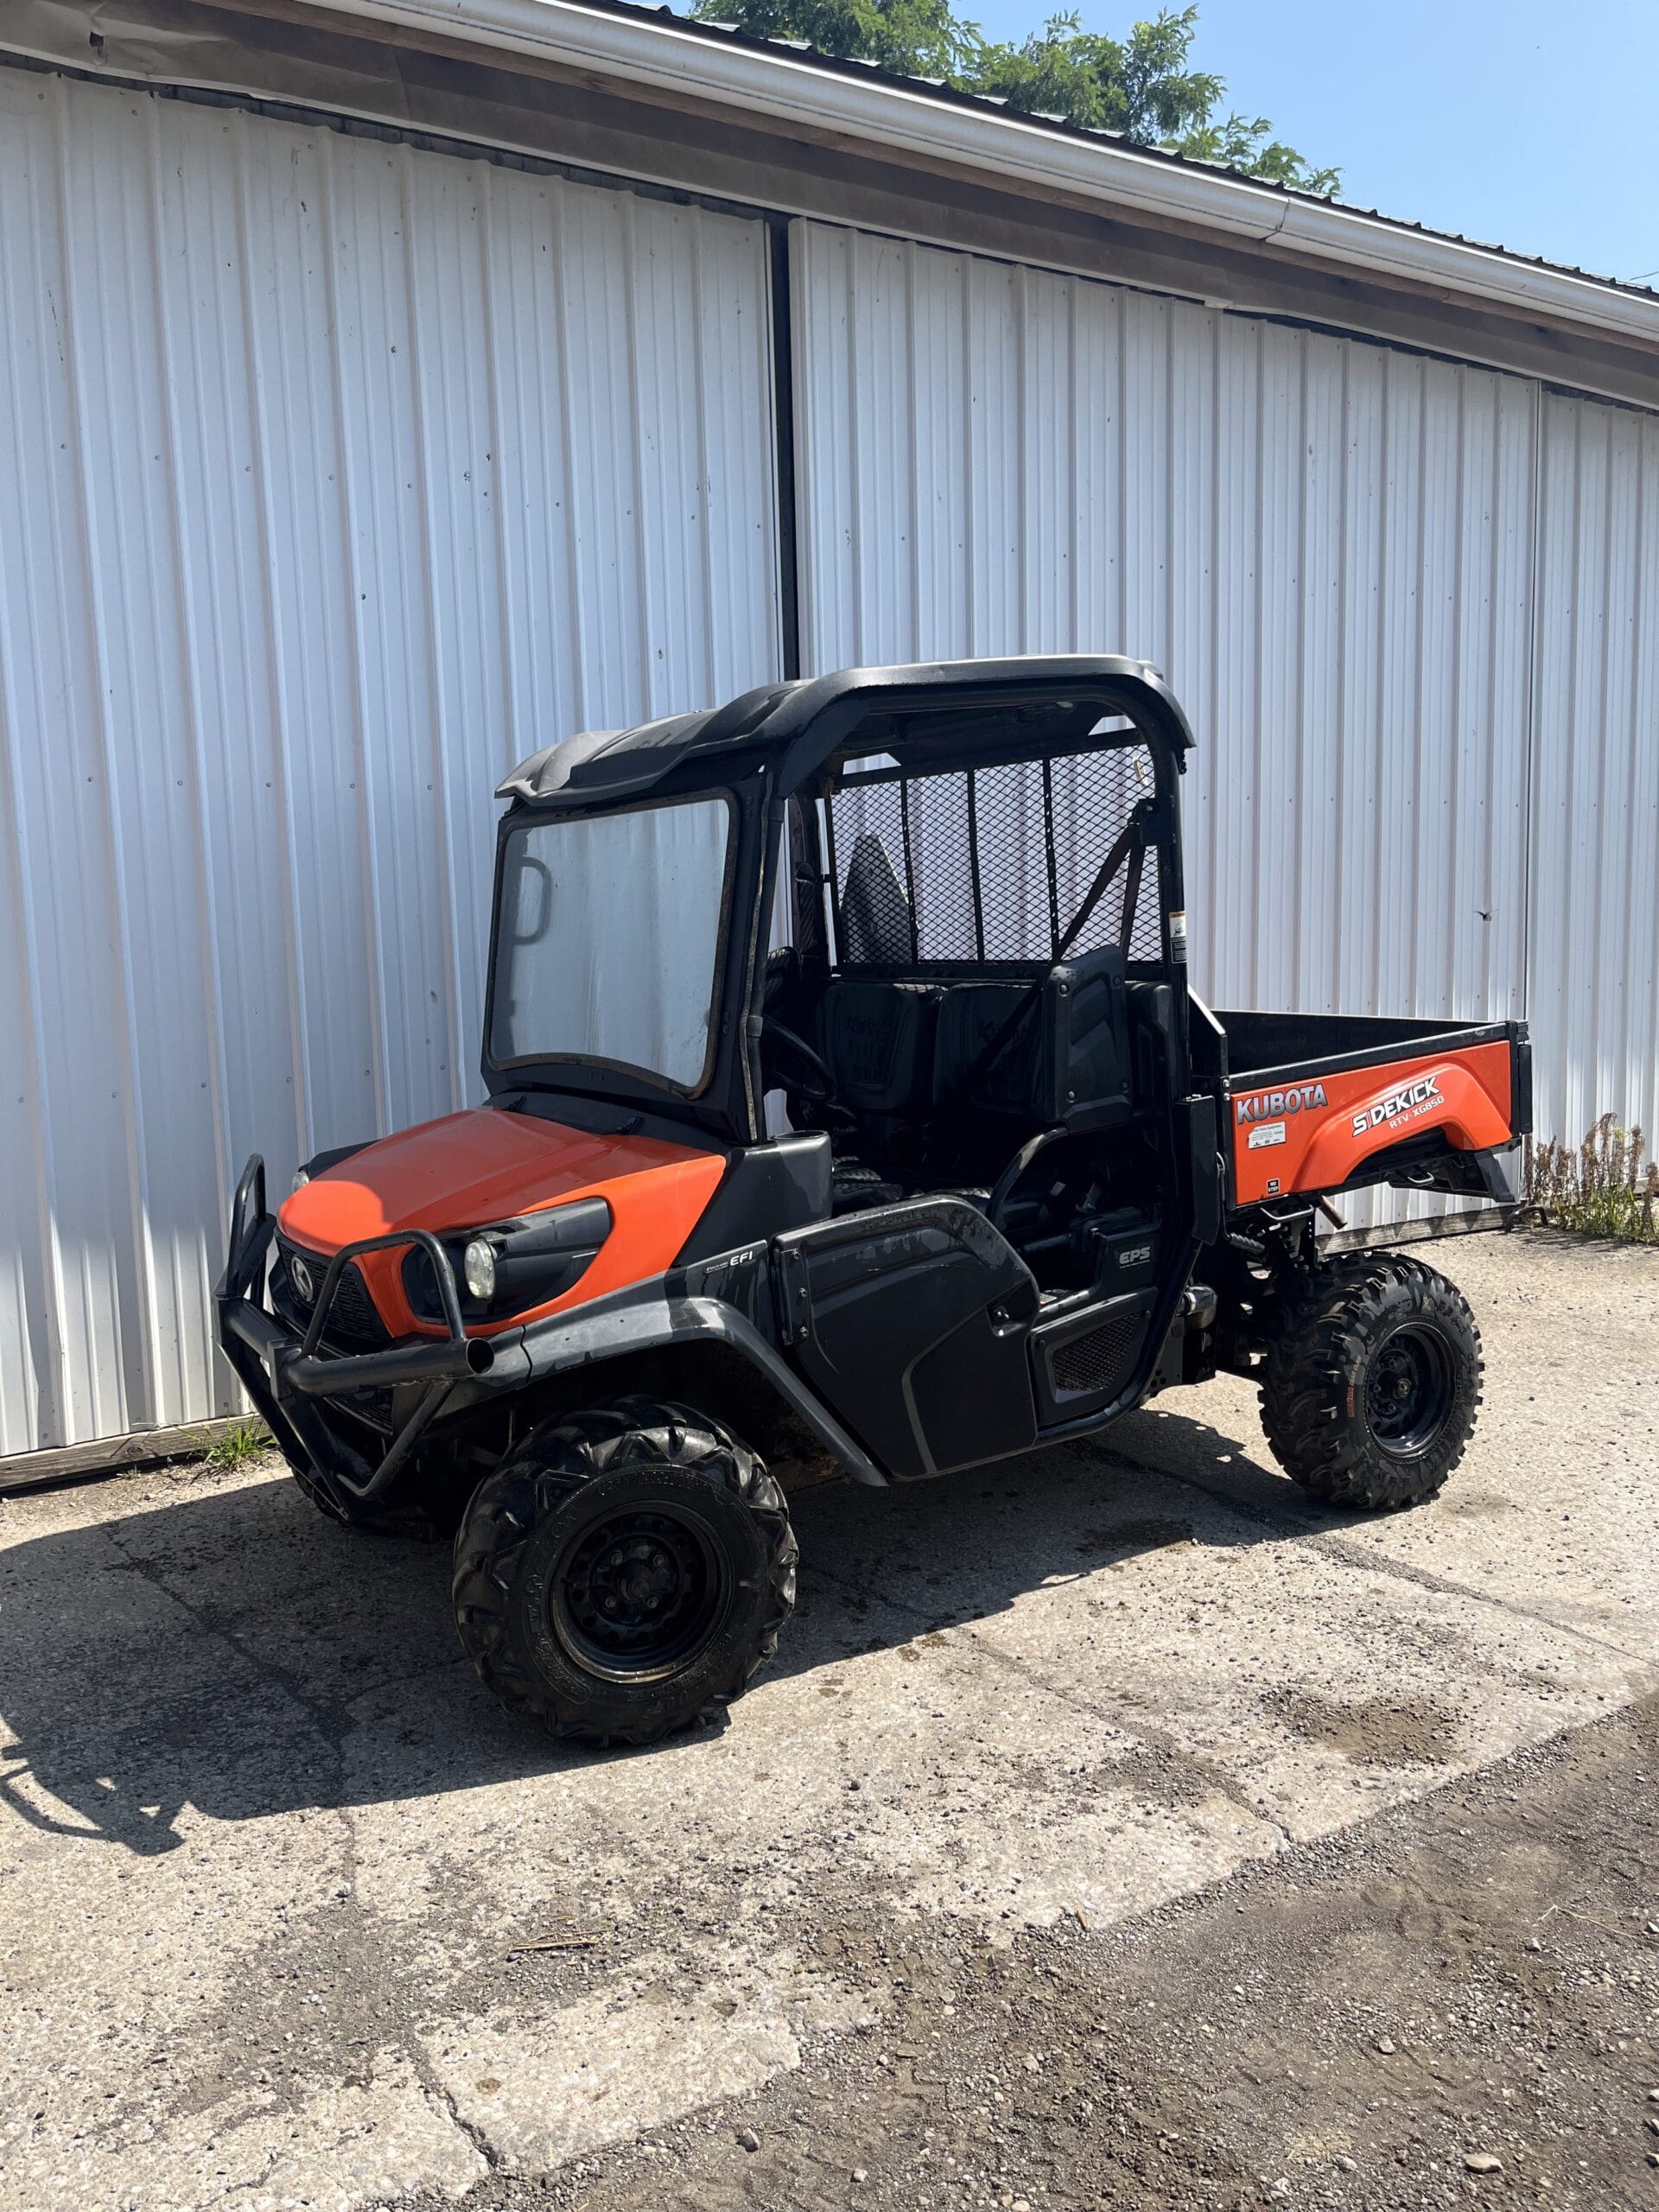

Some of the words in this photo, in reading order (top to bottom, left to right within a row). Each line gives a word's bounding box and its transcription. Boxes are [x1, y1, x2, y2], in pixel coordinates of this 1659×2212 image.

[1236, 1084, 1328, 1125] KUBOTA
[1352, 1077, 1441, 1137] SIDEKICK
[1389, 1096, 1445, 1129] RTV-XG850
[730, 1250, 753, 1266] EFI
[1119, 1246, 1150, 1264] EPS
